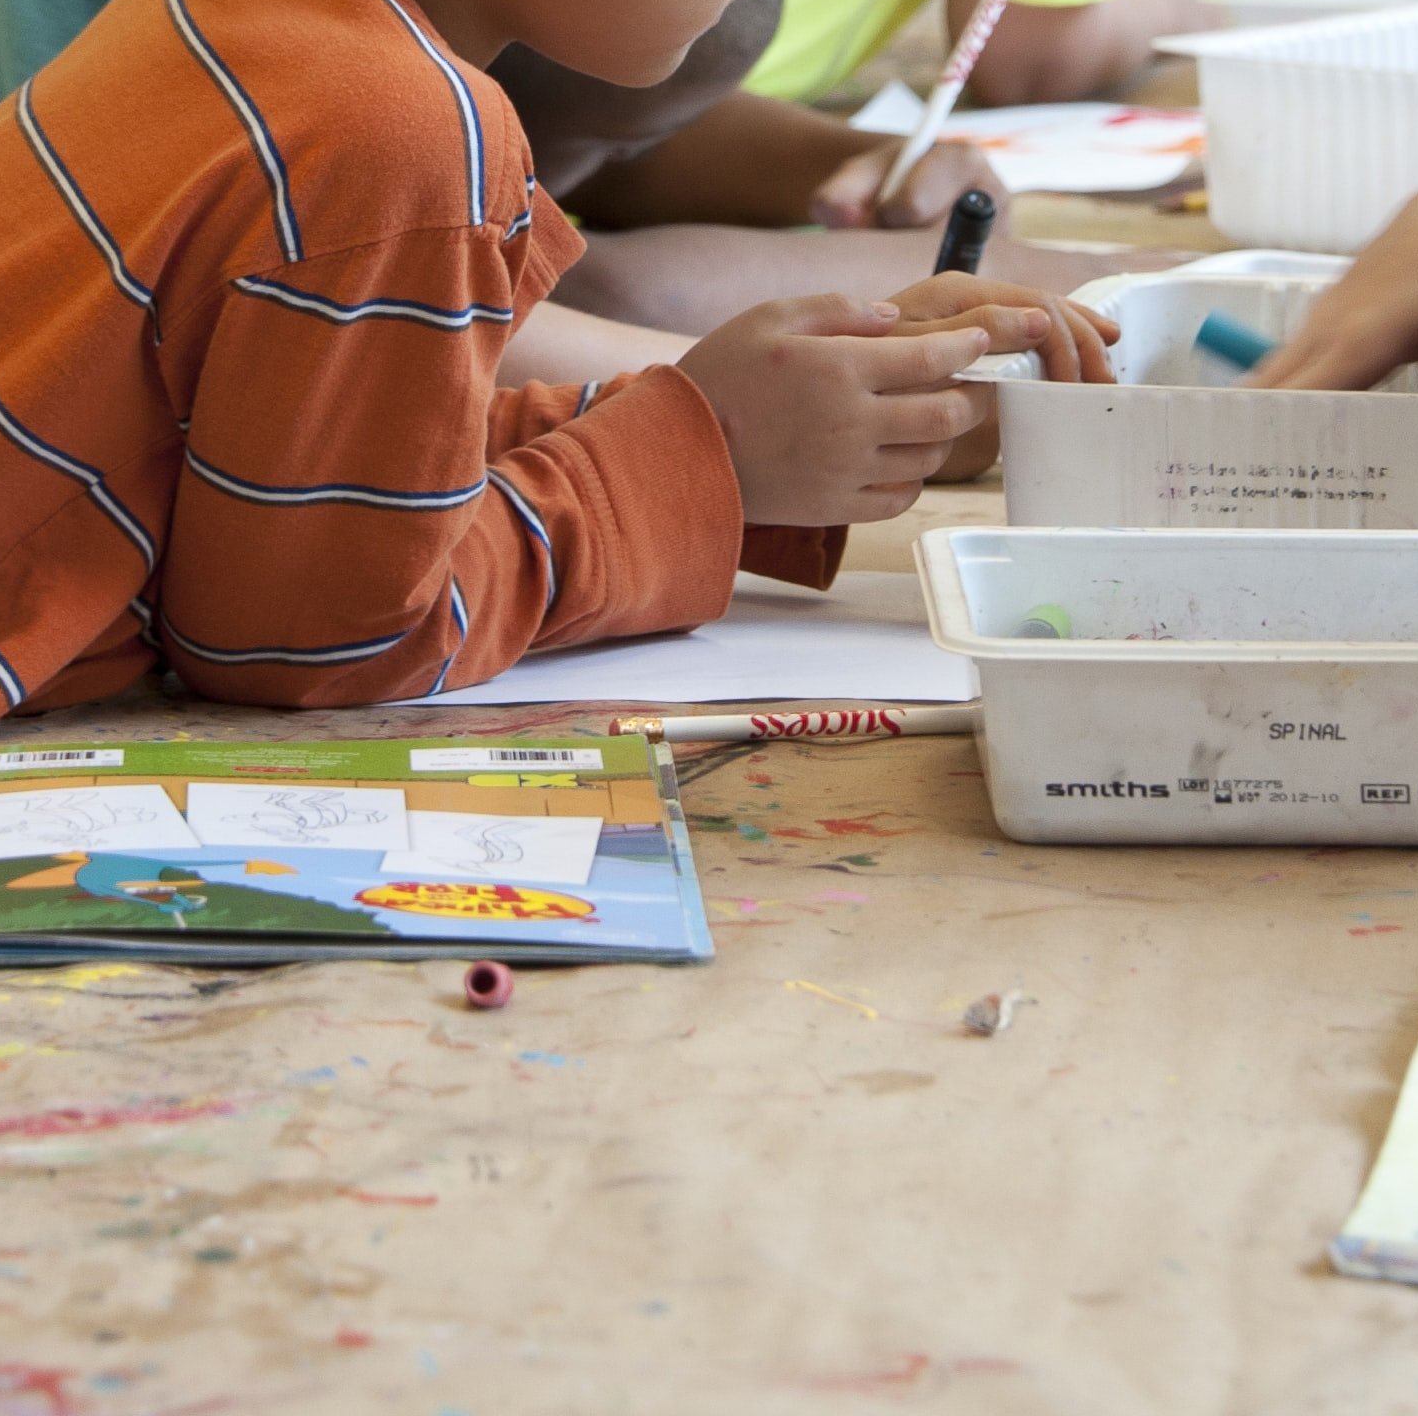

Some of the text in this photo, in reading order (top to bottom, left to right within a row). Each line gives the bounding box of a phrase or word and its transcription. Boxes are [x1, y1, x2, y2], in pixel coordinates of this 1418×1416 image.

[749, 709, 907, 739] Success
[1268, 722, 1347, 741] SPINAL
[1044, 780, 1170, 798] smiths
[1268, 792, 1340, 803] 2012-10
[1366, 788, 1404, 800] REF
